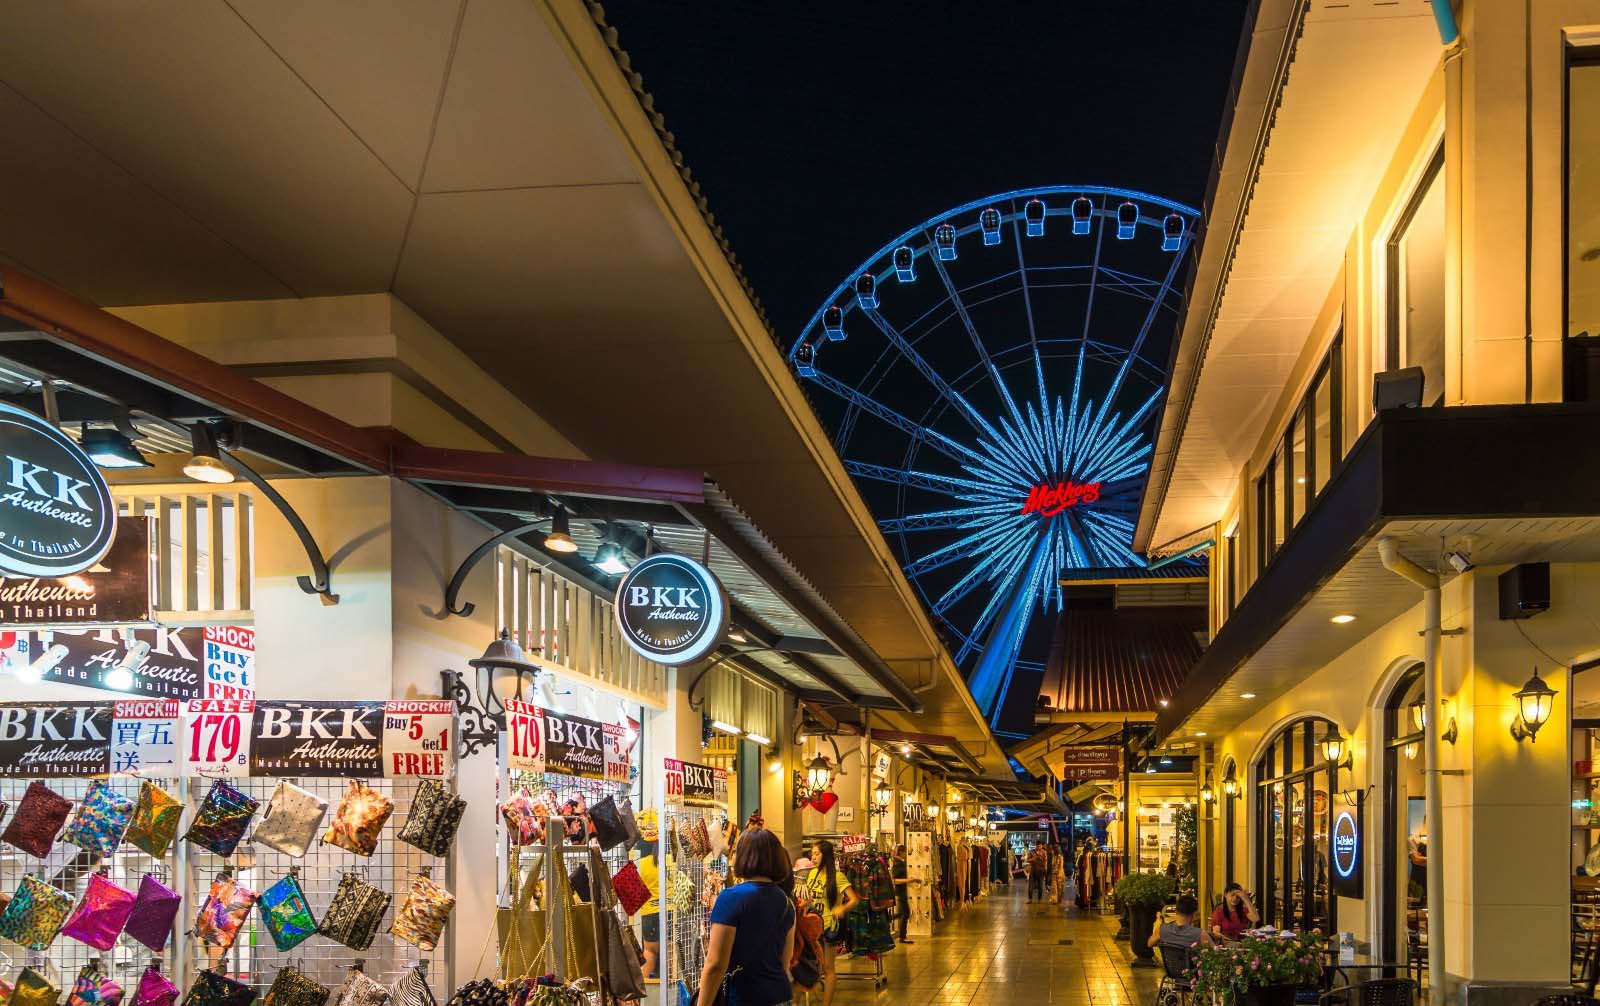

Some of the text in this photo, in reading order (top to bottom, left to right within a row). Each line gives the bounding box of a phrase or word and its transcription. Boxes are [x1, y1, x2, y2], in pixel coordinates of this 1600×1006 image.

[1, 491, 93, 528] Authentic
[1021, 482, 1101, 518] Mekhong
[31, 538, 82, 554] Thailand
[629, 587, 700, 608] BKK
[13, 604, 97, 618] Thailand
[648, 607, 700, 621] Authentic
[663, 630, 693, 647] Thailand
[207, 642, 250, 668] Buy
[54, 665, 88, 680] ade
[135, 678, 199, 698] hailand
[208, 663, 250, 686] Get
[208, 682, 256, 700] FRE
[116, 702, 178, 717] SHOCK!!!
[191, 700, 251, 712] SALE
[506, 700, 543, 718] SALE
[0, 707, 106, 741] BKK
[257, 707, 377, 740] BKK
[386, 715, 423, 740] Buy 5
[546, 715, 602, 751] BKK
[189, 714, 241, 763] 179
[422, 729, 448, 751] Get 1
[511, 714, 540, 758] 179
[19, 744, 105, 764] Authentic
[289, 740, 377, 760] Authentic
[564, 747, 603, 765] Authentic
[27, 764, 38, 773] in
[46, 764, 105, 773] Thailand
[319, 760, 377, 769] Thailand
[392, 752, 445, 776] FREE
[608, 762, 627, 779] FREE
[666, 772, 683, 796] 179
[684, 765, 714, 788] BKK
